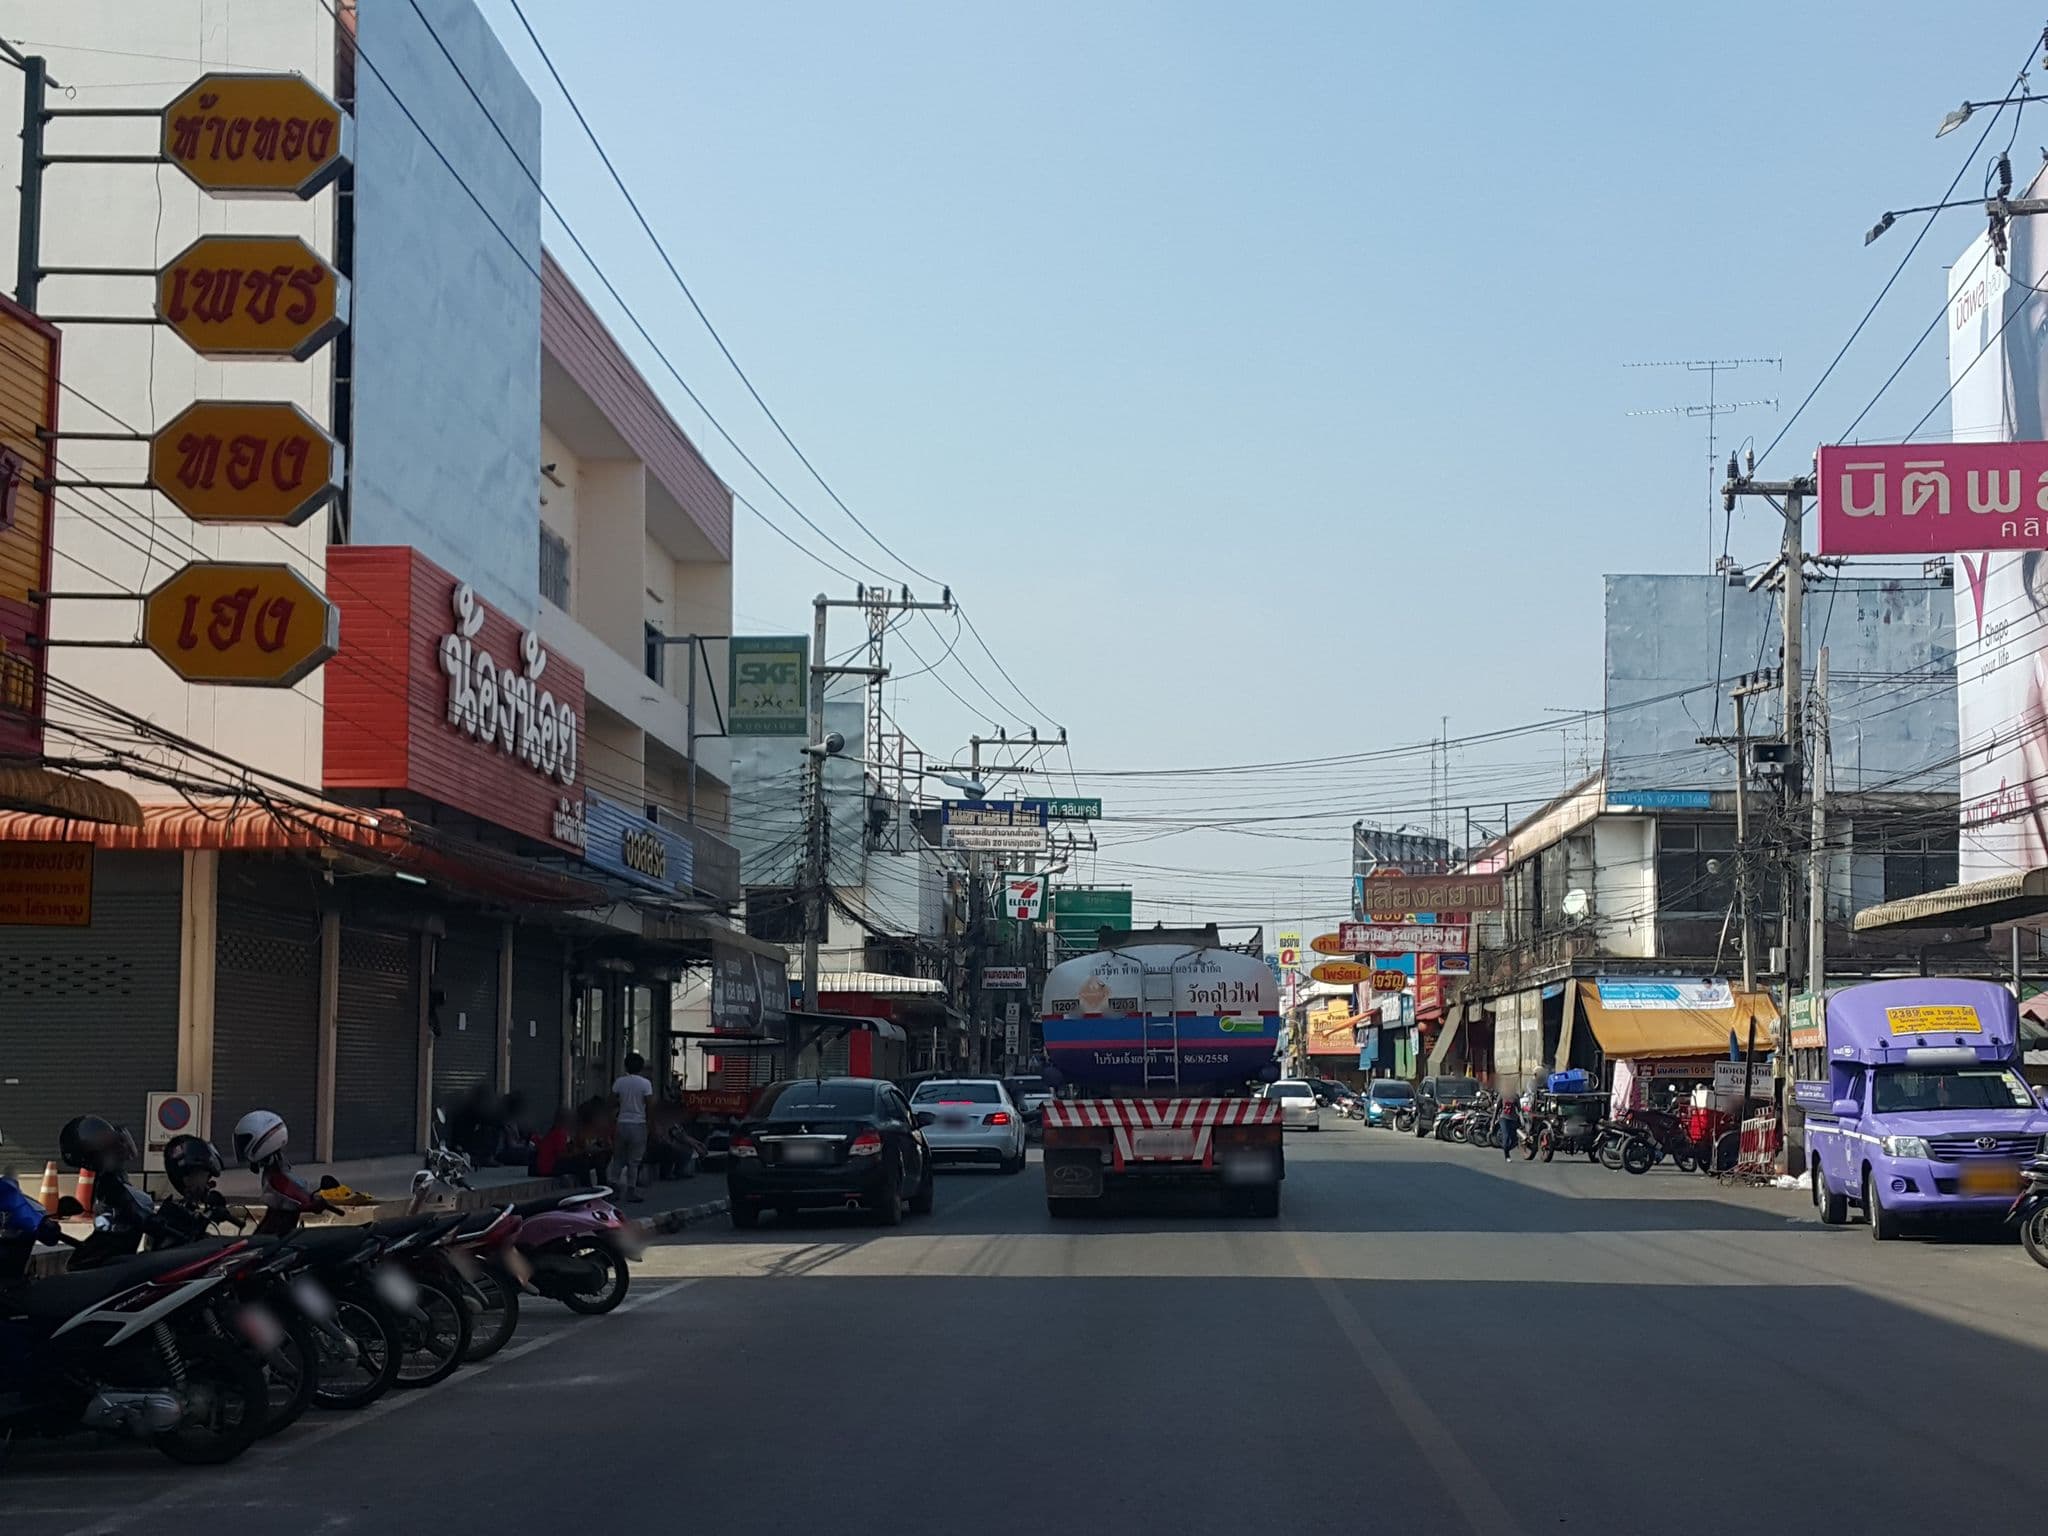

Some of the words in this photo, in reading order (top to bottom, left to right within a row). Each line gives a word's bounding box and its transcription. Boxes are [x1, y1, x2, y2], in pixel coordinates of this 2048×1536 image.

[171, 93, 334, 162] ห้างทอง
[166, 264, 325, 326] เพชร
[175, 431, 311, 492] ทอง
[1840, 460, 2048, 517] นิติพ
[2001, 517, 2048, 538] คลิ
[177, 584, 297, 654] เฮง
[1984, 618, 2010, 648] Shape
[439, 583, 578, 786] น้องน้อย
[739, 662, 797, 685] SKF
[1365, 880, 1500, 910] เสียงสยาม
[1186, 981, 1260, 1011] วัตถุไวไฟ
